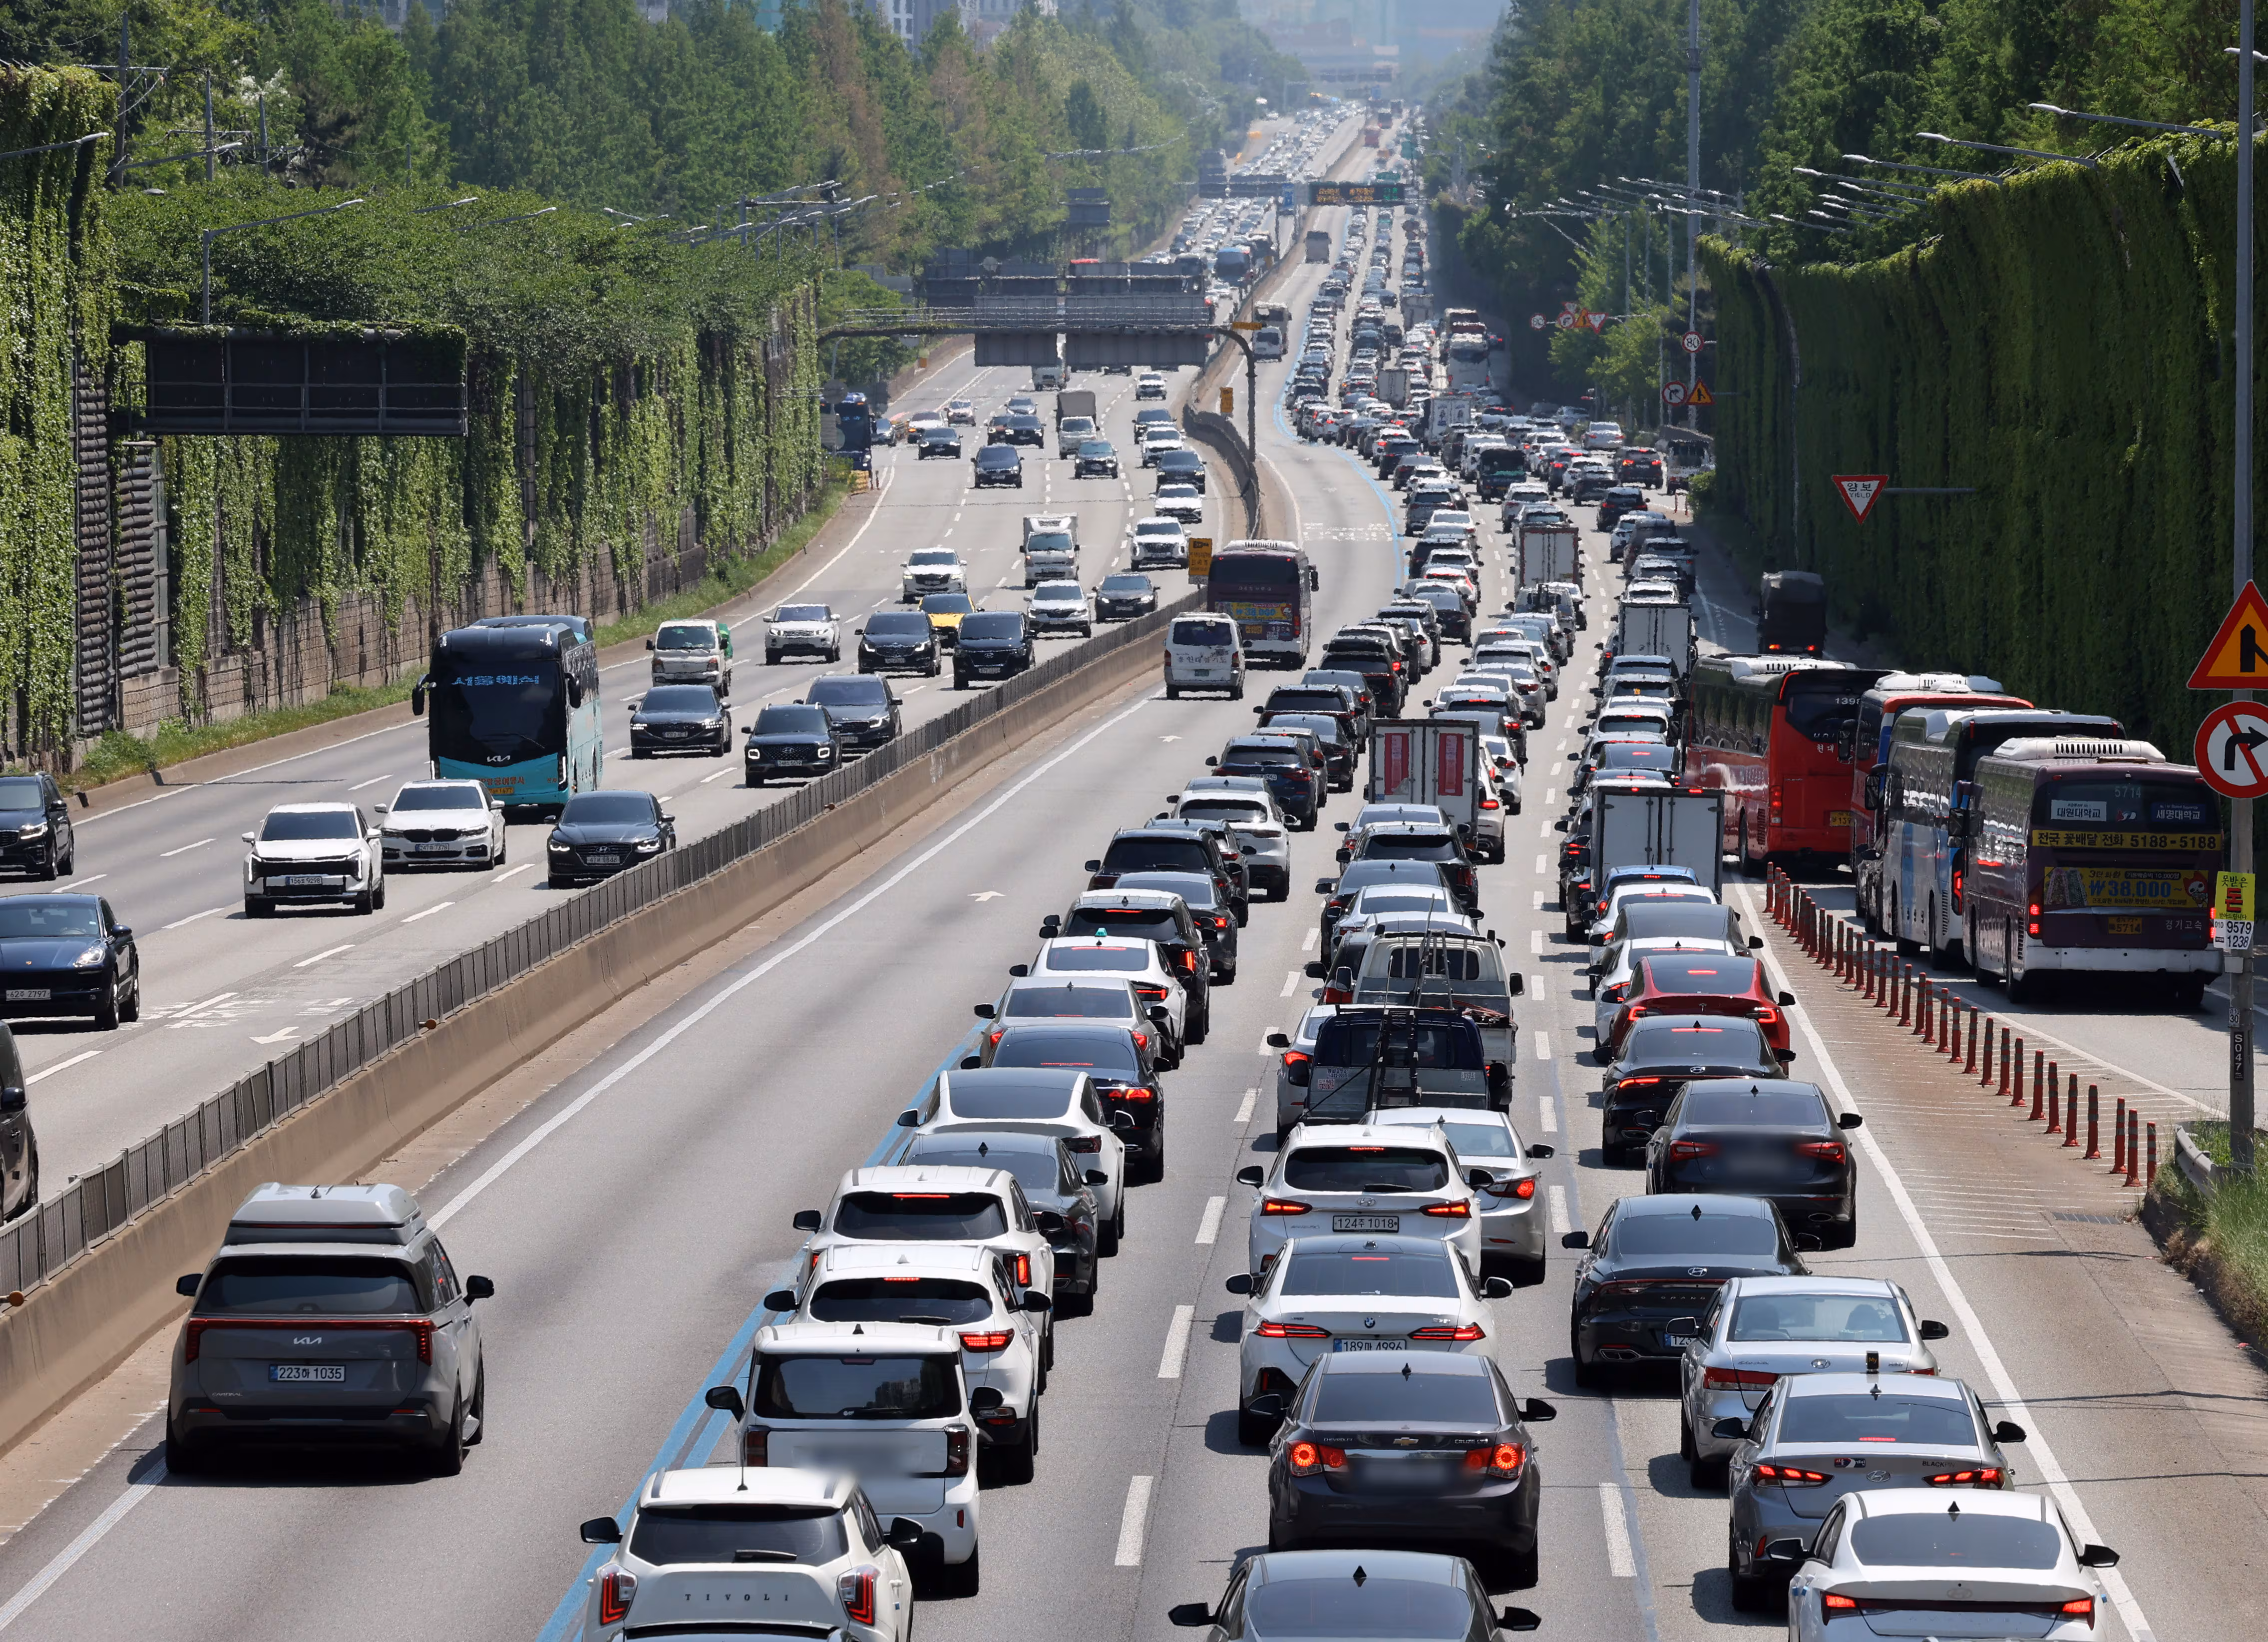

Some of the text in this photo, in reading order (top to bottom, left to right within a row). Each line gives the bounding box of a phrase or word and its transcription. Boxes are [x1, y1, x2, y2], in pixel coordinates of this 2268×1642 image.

[1686, 338, 1700, 348] 80
[1847, 482, 1873, 491] 양보
[2115, 786, 2141, 798] 5714
[2057, 807, 2101, 819] 대원대학교
[2156, 809, 2201, 820] 세명대학교
[2038, 832, 2060, 845] 전국
[2063, 832, 2098, 846] 꽃배달
[2102, 834, 2124, 846] 전화
[2222, 875, 2248, 888] 못받은
[2225, 887, 2244, 913] 돈
[2226, 921, 2252, 934] 9579
[2227, 935, 2249, 947] 1238
[2230, 1014, 2239, 1023] 30
[1338, 1219, 1394, 1229] 124주 1018
[293, 1336, 322, 1345] KIA
[1376, 1341, 1402, 1351] 4996
[278, 1366, 344, 1380] 223하 1035
